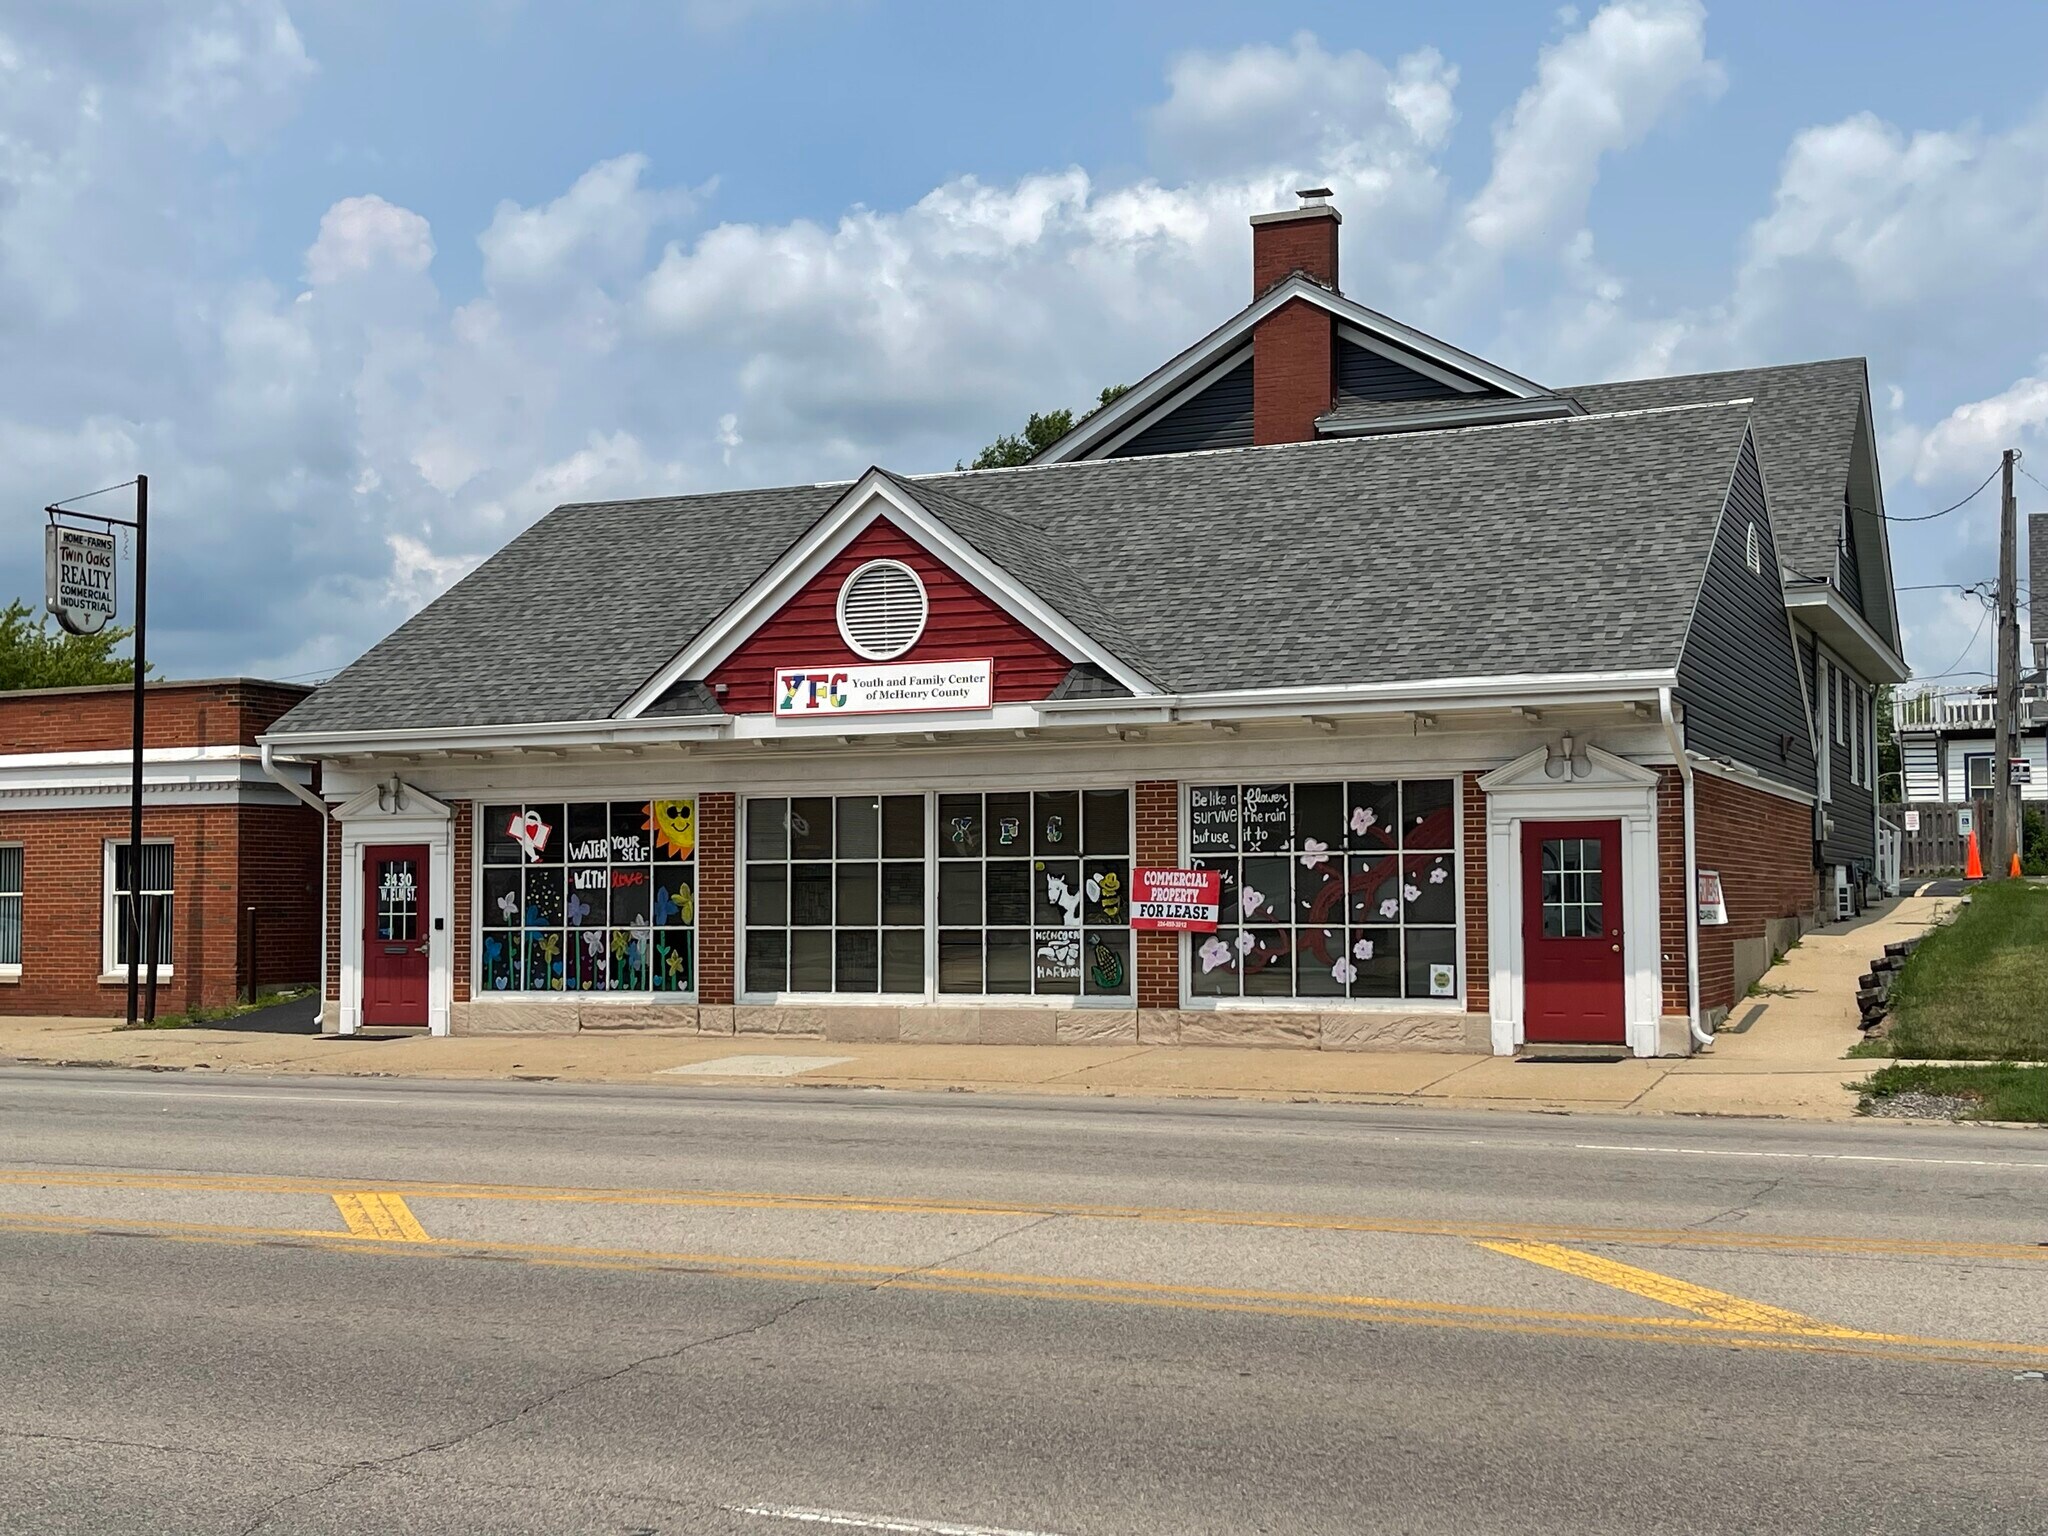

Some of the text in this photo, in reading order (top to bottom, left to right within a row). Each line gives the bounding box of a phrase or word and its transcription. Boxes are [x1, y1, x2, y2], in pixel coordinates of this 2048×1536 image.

[60, 546, 110, 568] Twin Oaks
[61, 564, 111, 589] REALTY
[60, 585, 112, 602] COMMERCIAL
[60, 599, 112, 613] INDUSTRIAL
[852, 674, 986, 689] Youth and Family Center
[780, 673, 848, 709] YFC
[866, 685, 970, 702] of McHenry County
[1192, 790, 1207, 807] Be
[1209, 790, 1227, 807] like
[1230, 795, 1237, 805] a
[1193, 806, 1286, 824] survive the rain
[1192, 826, 1268, 844] but use it to
[569, 836, 640, 860] WATER YOUR
[622, 847, 650, 861] SELF
[384, 873, 412, 887] 3430
[1144, 871, 1208, 888] COMMERCIAL
[1151, 888, 1199, 903] PROPERTY
[1140, 904, 1209, 920] FOR LEASE
